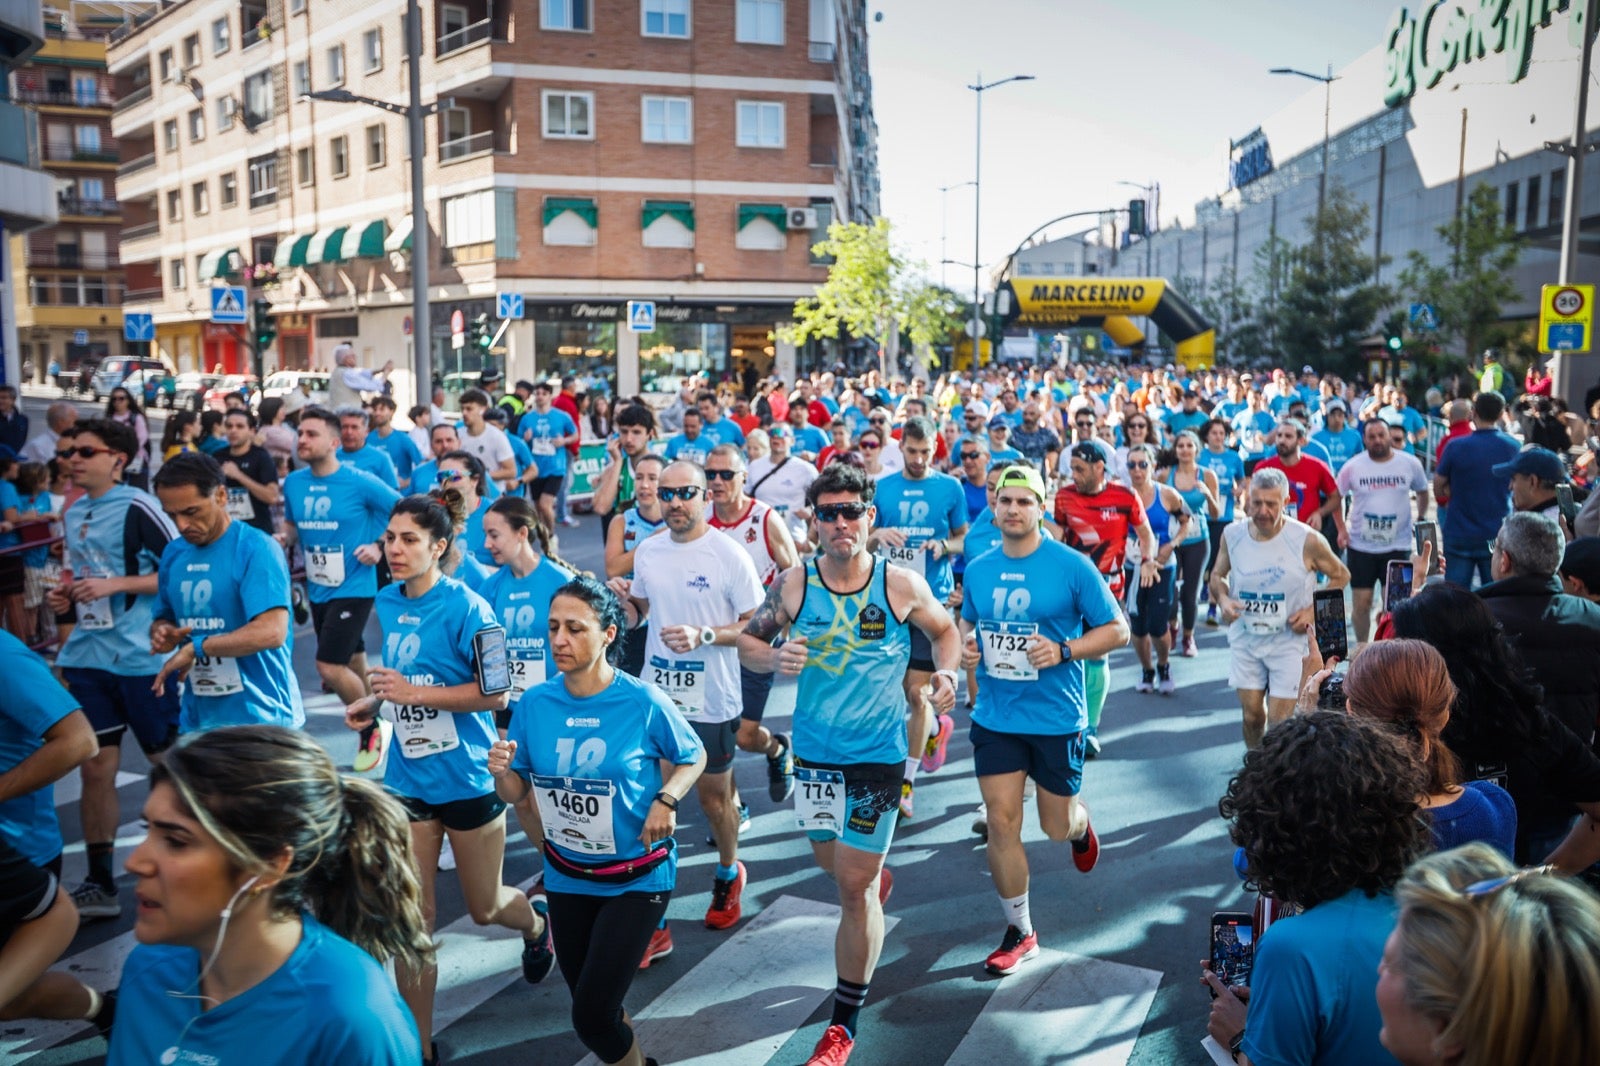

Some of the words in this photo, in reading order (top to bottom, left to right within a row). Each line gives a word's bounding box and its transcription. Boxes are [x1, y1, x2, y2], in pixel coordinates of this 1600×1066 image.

[1030, 285, 1145, 302] MARCELINO
[1559, 296, 1578, 308] 30
[304, 496, 332, 520] 18
[899, 500, 930, 526] 18
[298, 521, 339, 531] MARCELINO
[890, 548, 914, 560] 646
[180, 579, 213, 616] 18
[992, 587, 1032, 620] 18
[503, 604, 536, 637] 18
[386, 632, 421, 672] 18
[989, 634, 1027, 651] 1732
[654, 669, 695, 687] 2118
[394, 705, 439, 723] 1459
[556, 737, 607, 779] 18
[802, 783, 835, 800] 774
[548, 790, 599, 817] 1460
